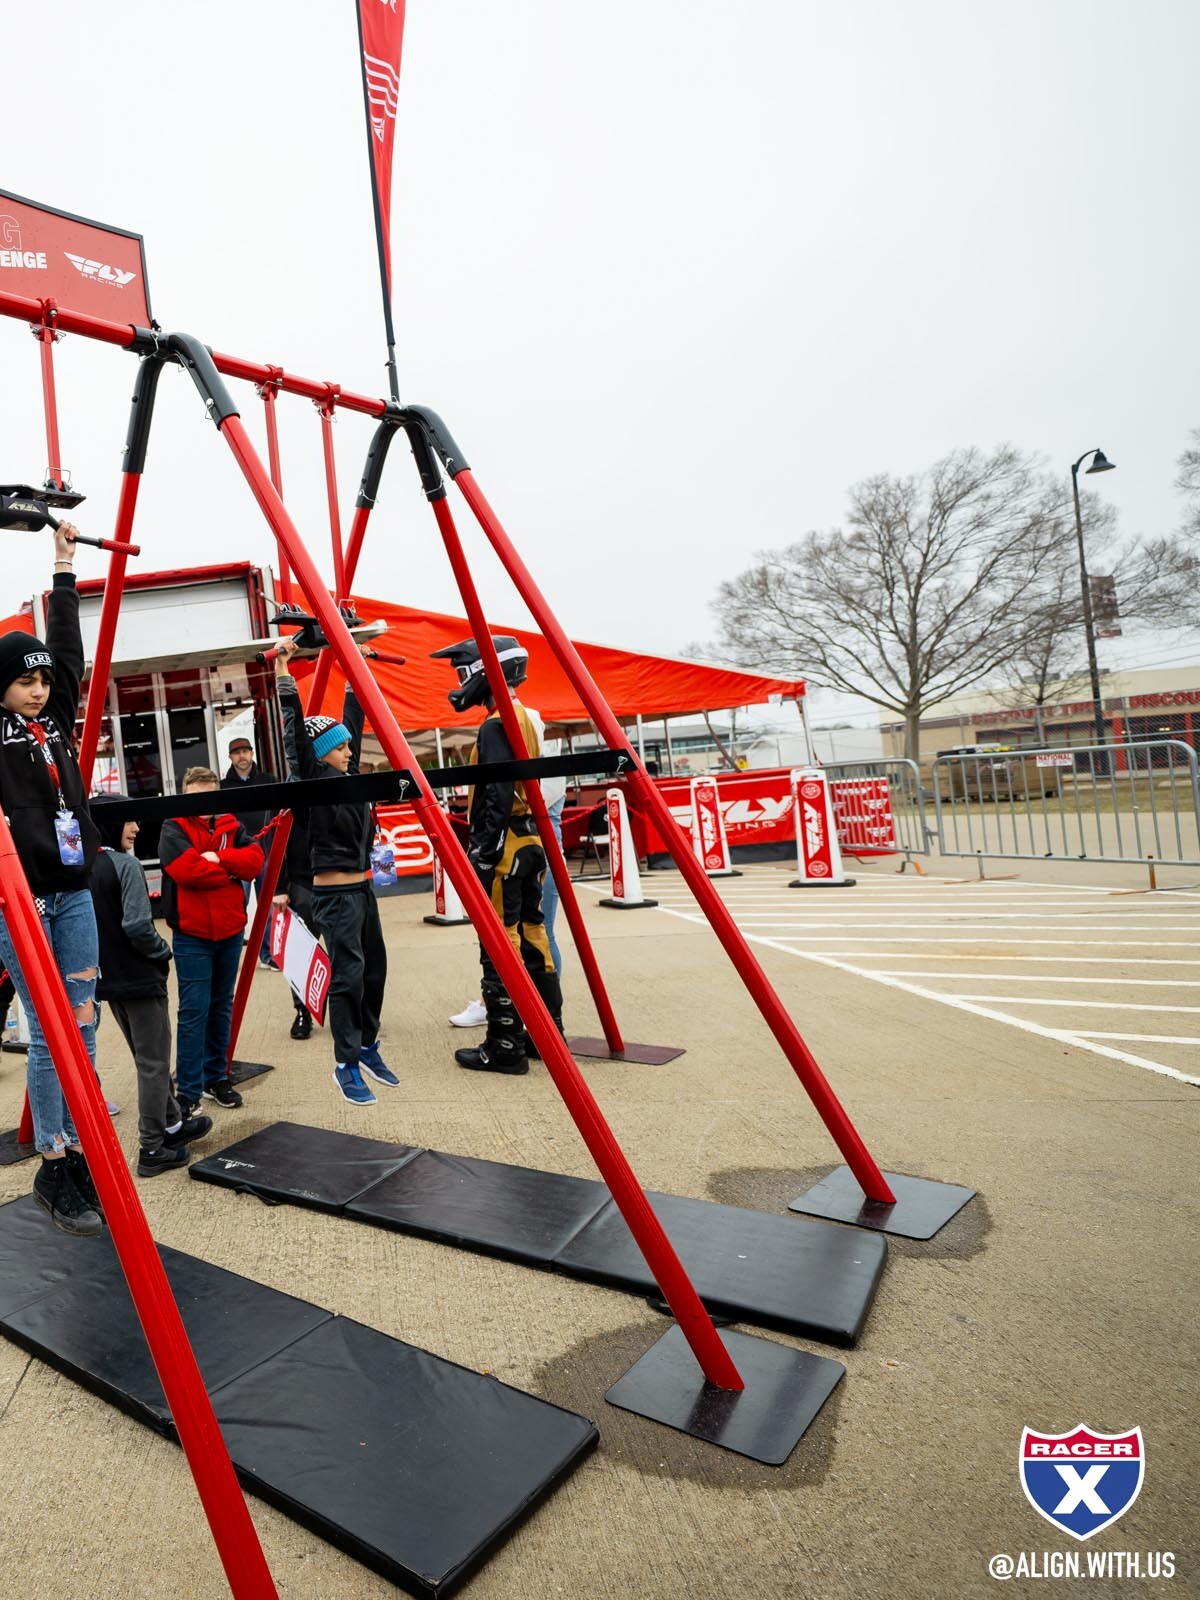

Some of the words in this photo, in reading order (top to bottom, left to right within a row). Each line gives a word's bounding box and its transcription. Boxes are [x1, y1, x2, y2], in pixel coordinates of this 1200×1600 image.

[63, 251, 137, 285] FLY
[81, 273, 124, 289] RACING
[308, 959, 328, 1013] WPS
